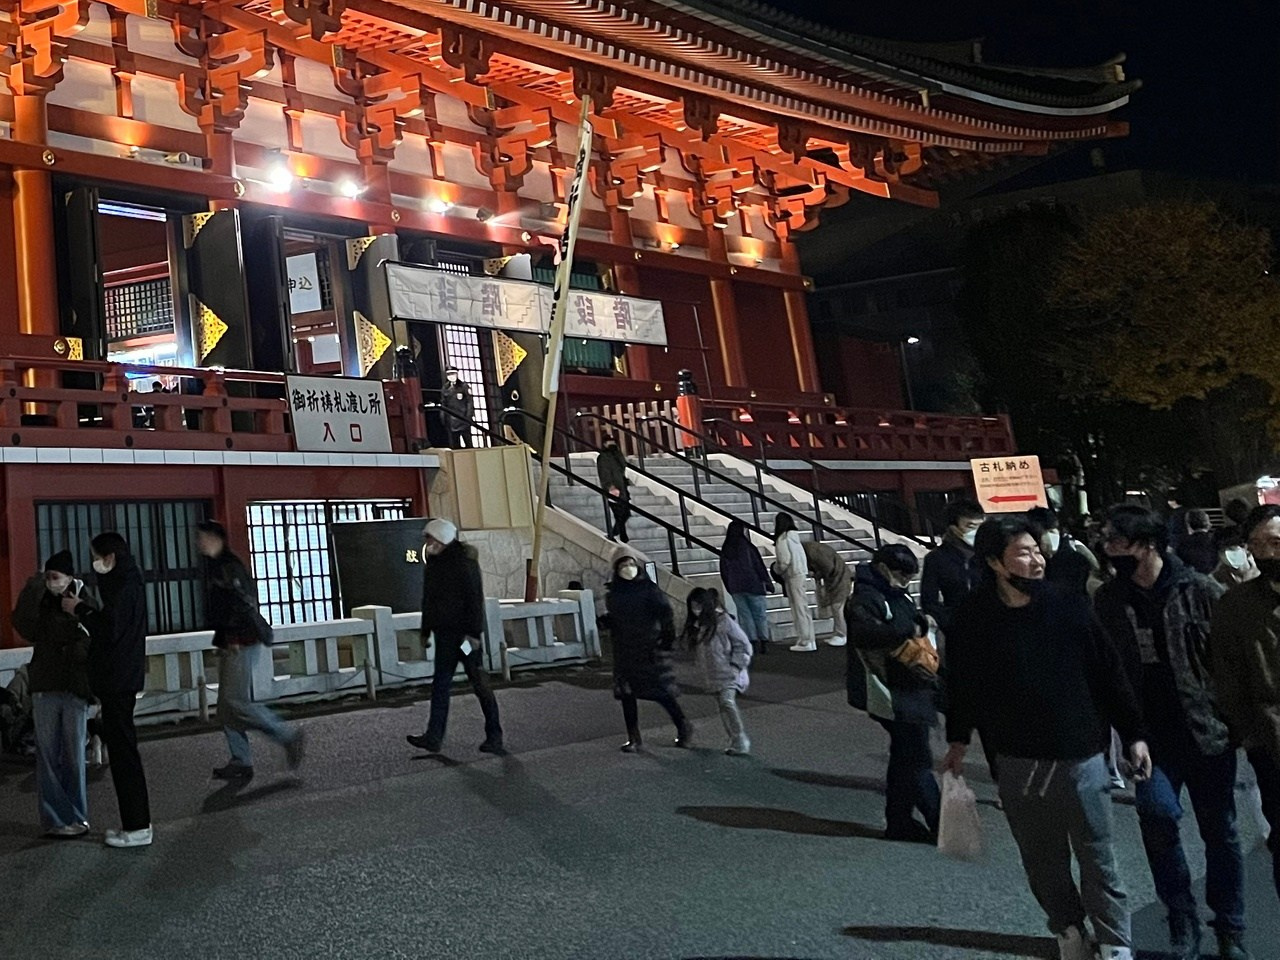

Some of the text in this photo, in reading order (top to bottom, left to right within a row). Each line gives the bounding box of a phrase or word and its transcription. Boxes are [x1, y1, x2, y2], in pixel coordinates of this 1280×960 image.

[323, 422, 363, 442] 入口
[979, 460, 1030, 473] 古札納め
